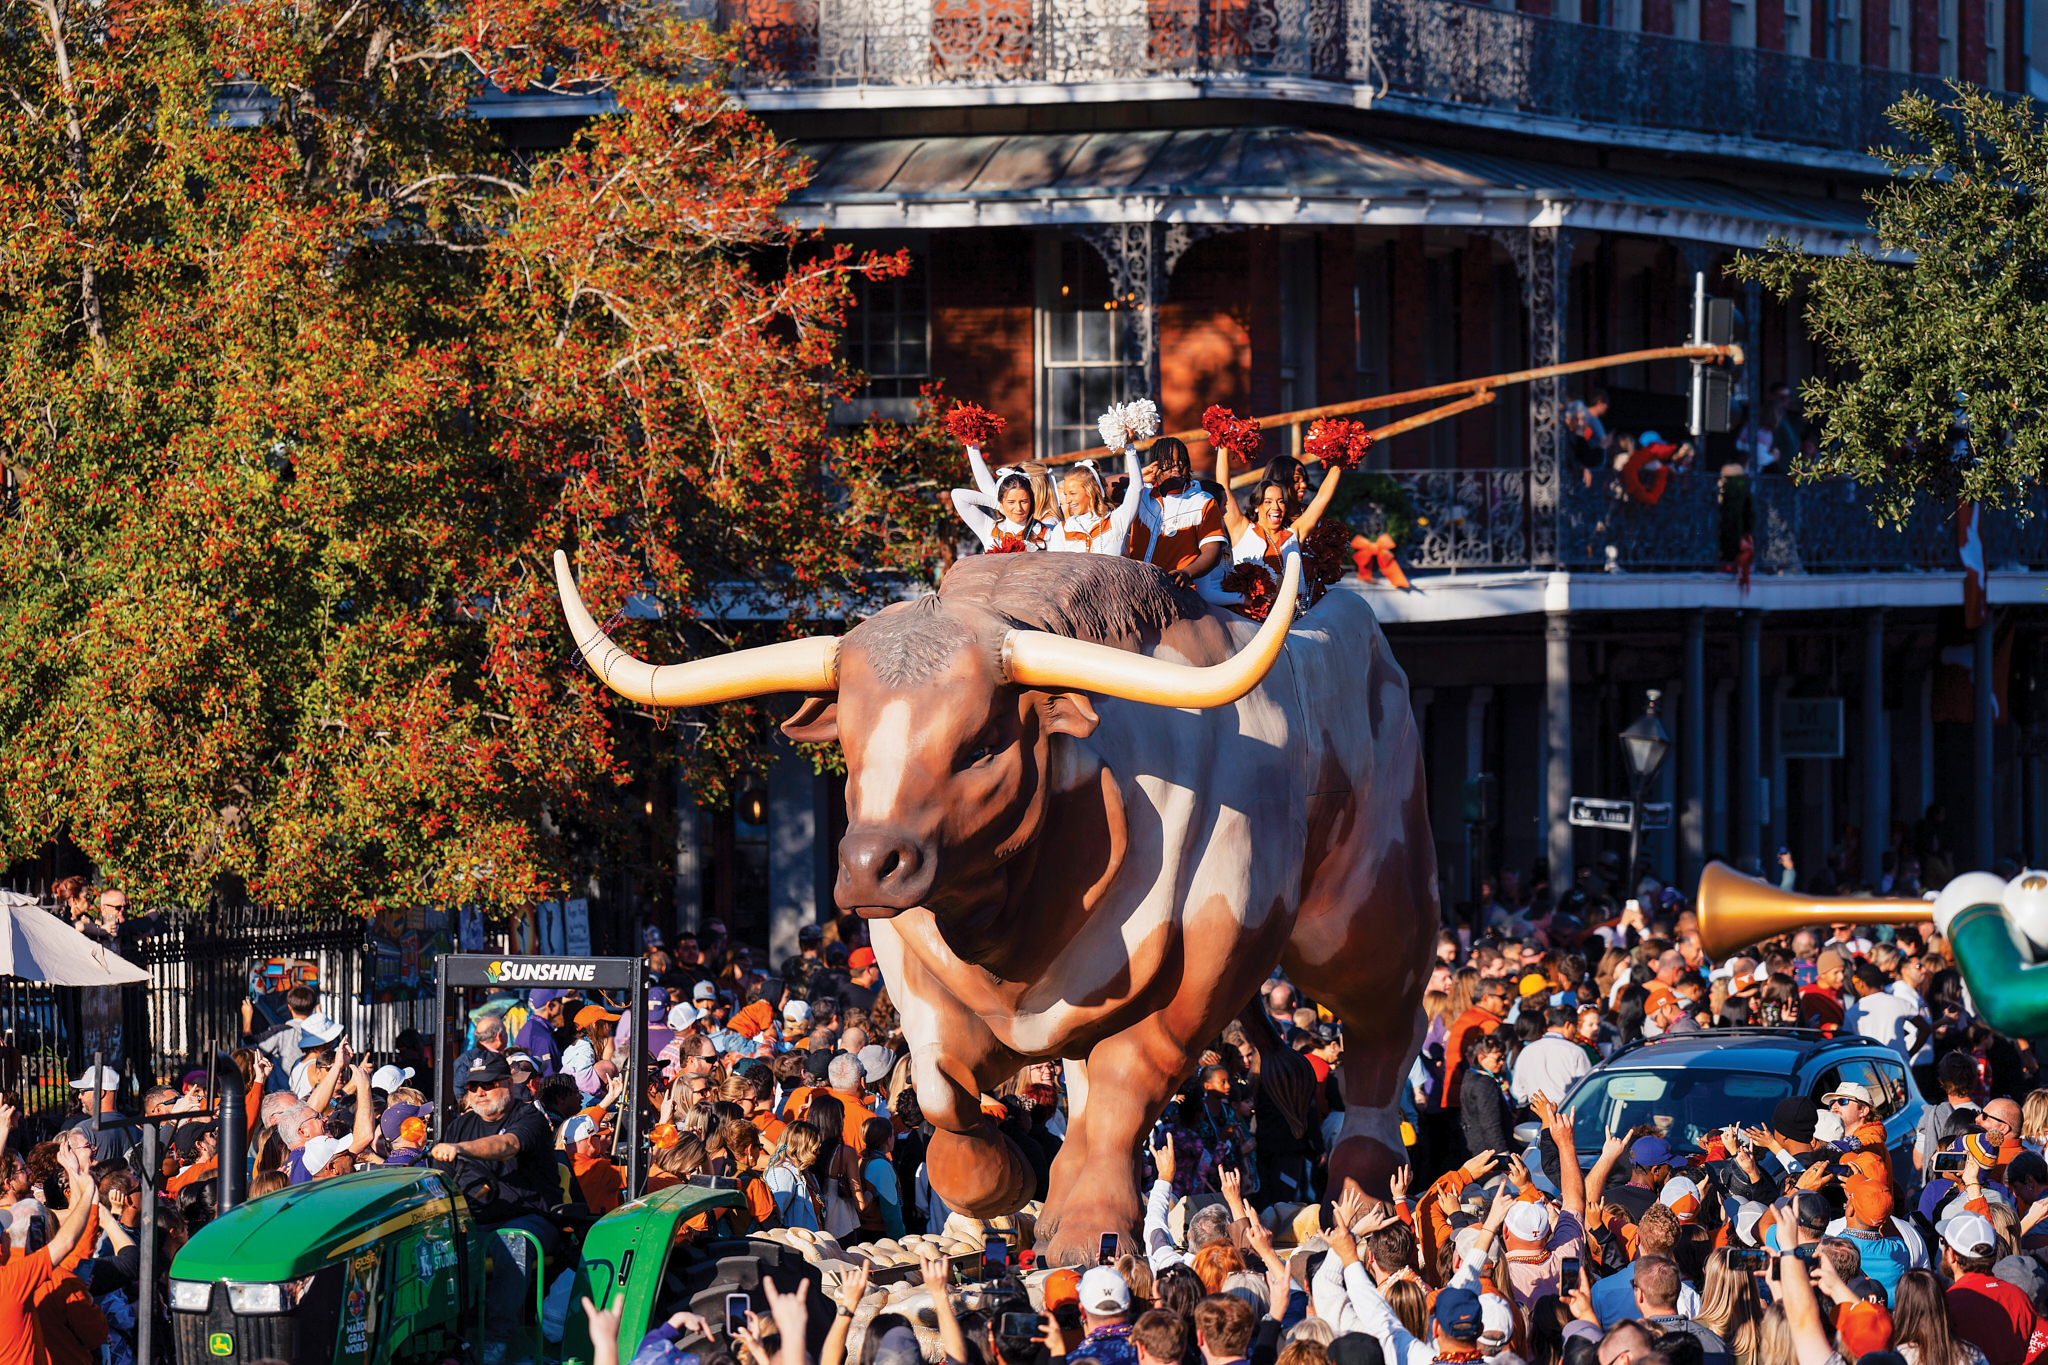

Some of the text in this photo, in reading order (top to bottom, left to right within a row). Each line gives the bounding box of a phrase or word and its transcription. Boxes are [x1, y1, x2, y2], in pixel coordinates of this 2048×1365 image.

[1577, 806, 1625, 822] St. Ann
[498, 961, 596, 982] SUNSHINE
[1532, 1230, 1540, 1238] T
[1103, 1288, 1114, 1297] W
[346, 1320, 367, 1334] MARDI
[347, 1331, 366, 1344] GRAS
[344, 1341, 368, 1355] WORLD
